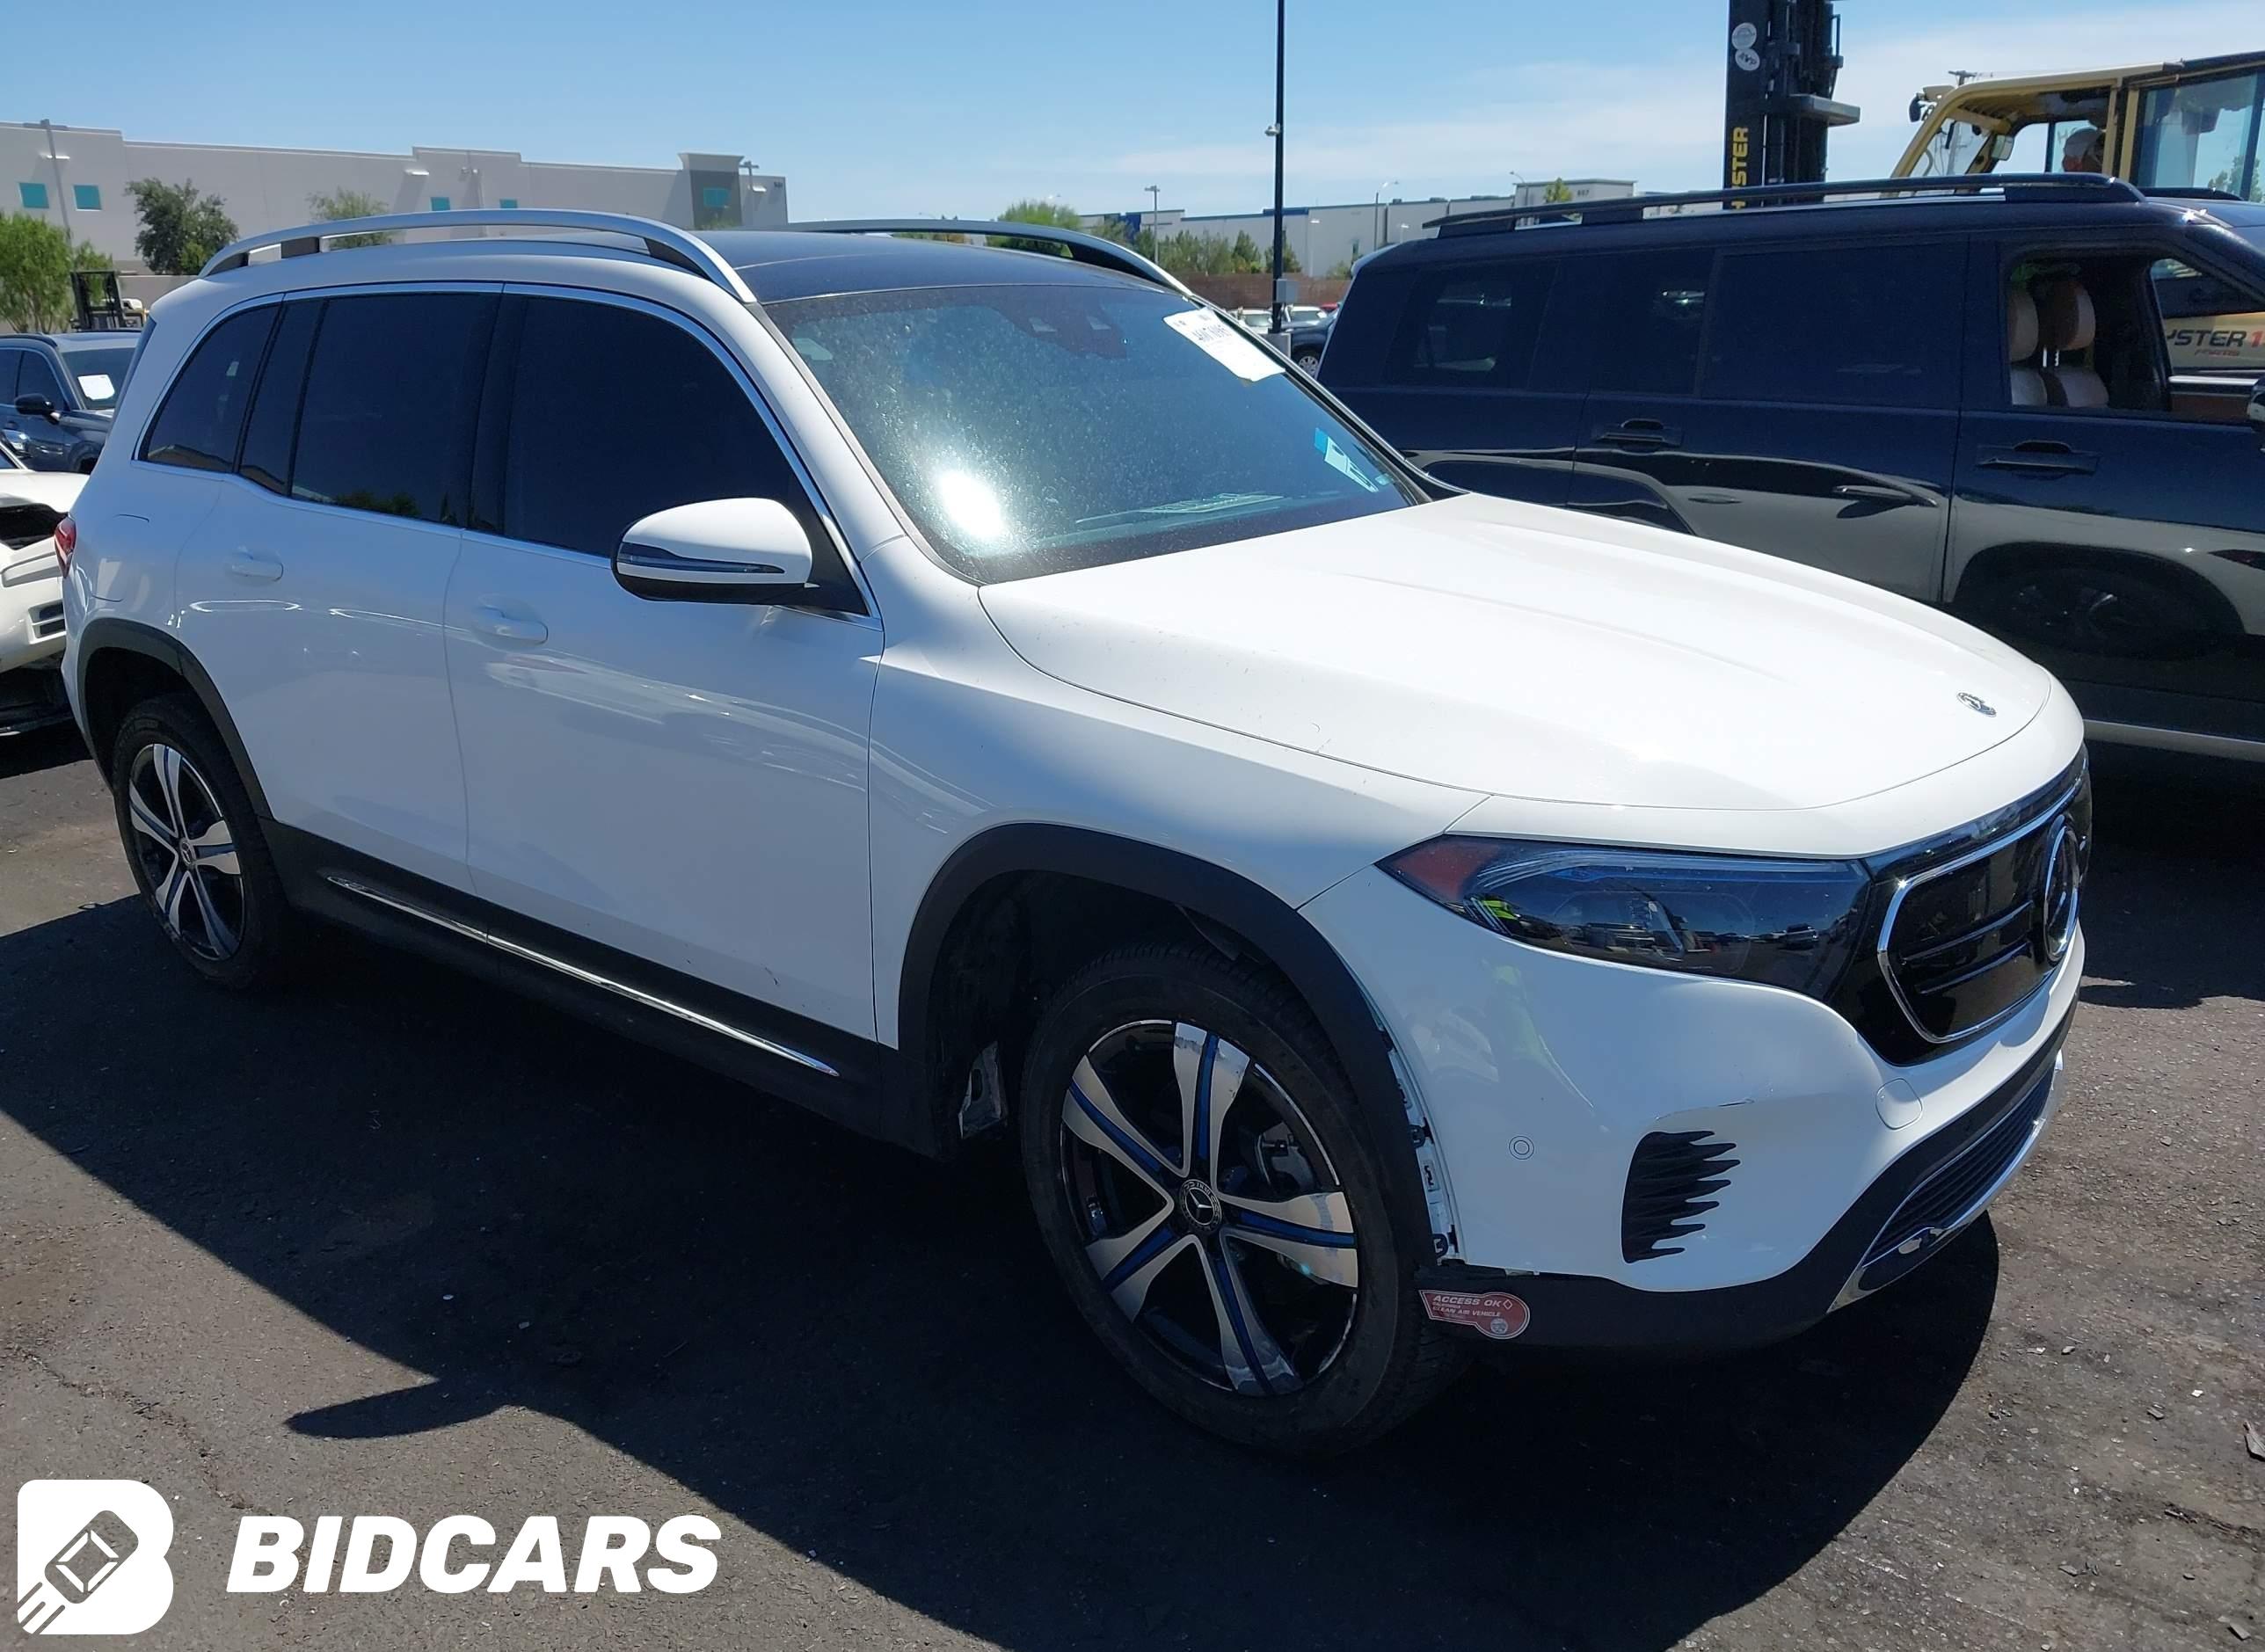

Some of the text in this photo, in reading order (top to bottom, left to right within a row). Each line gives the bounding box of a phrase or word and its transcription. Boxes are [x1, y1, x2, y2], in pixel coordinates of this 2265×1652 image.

[1730, 127, 1749, 210] STER
[1432, 1295, 1503, 1308] ACCESS OK
